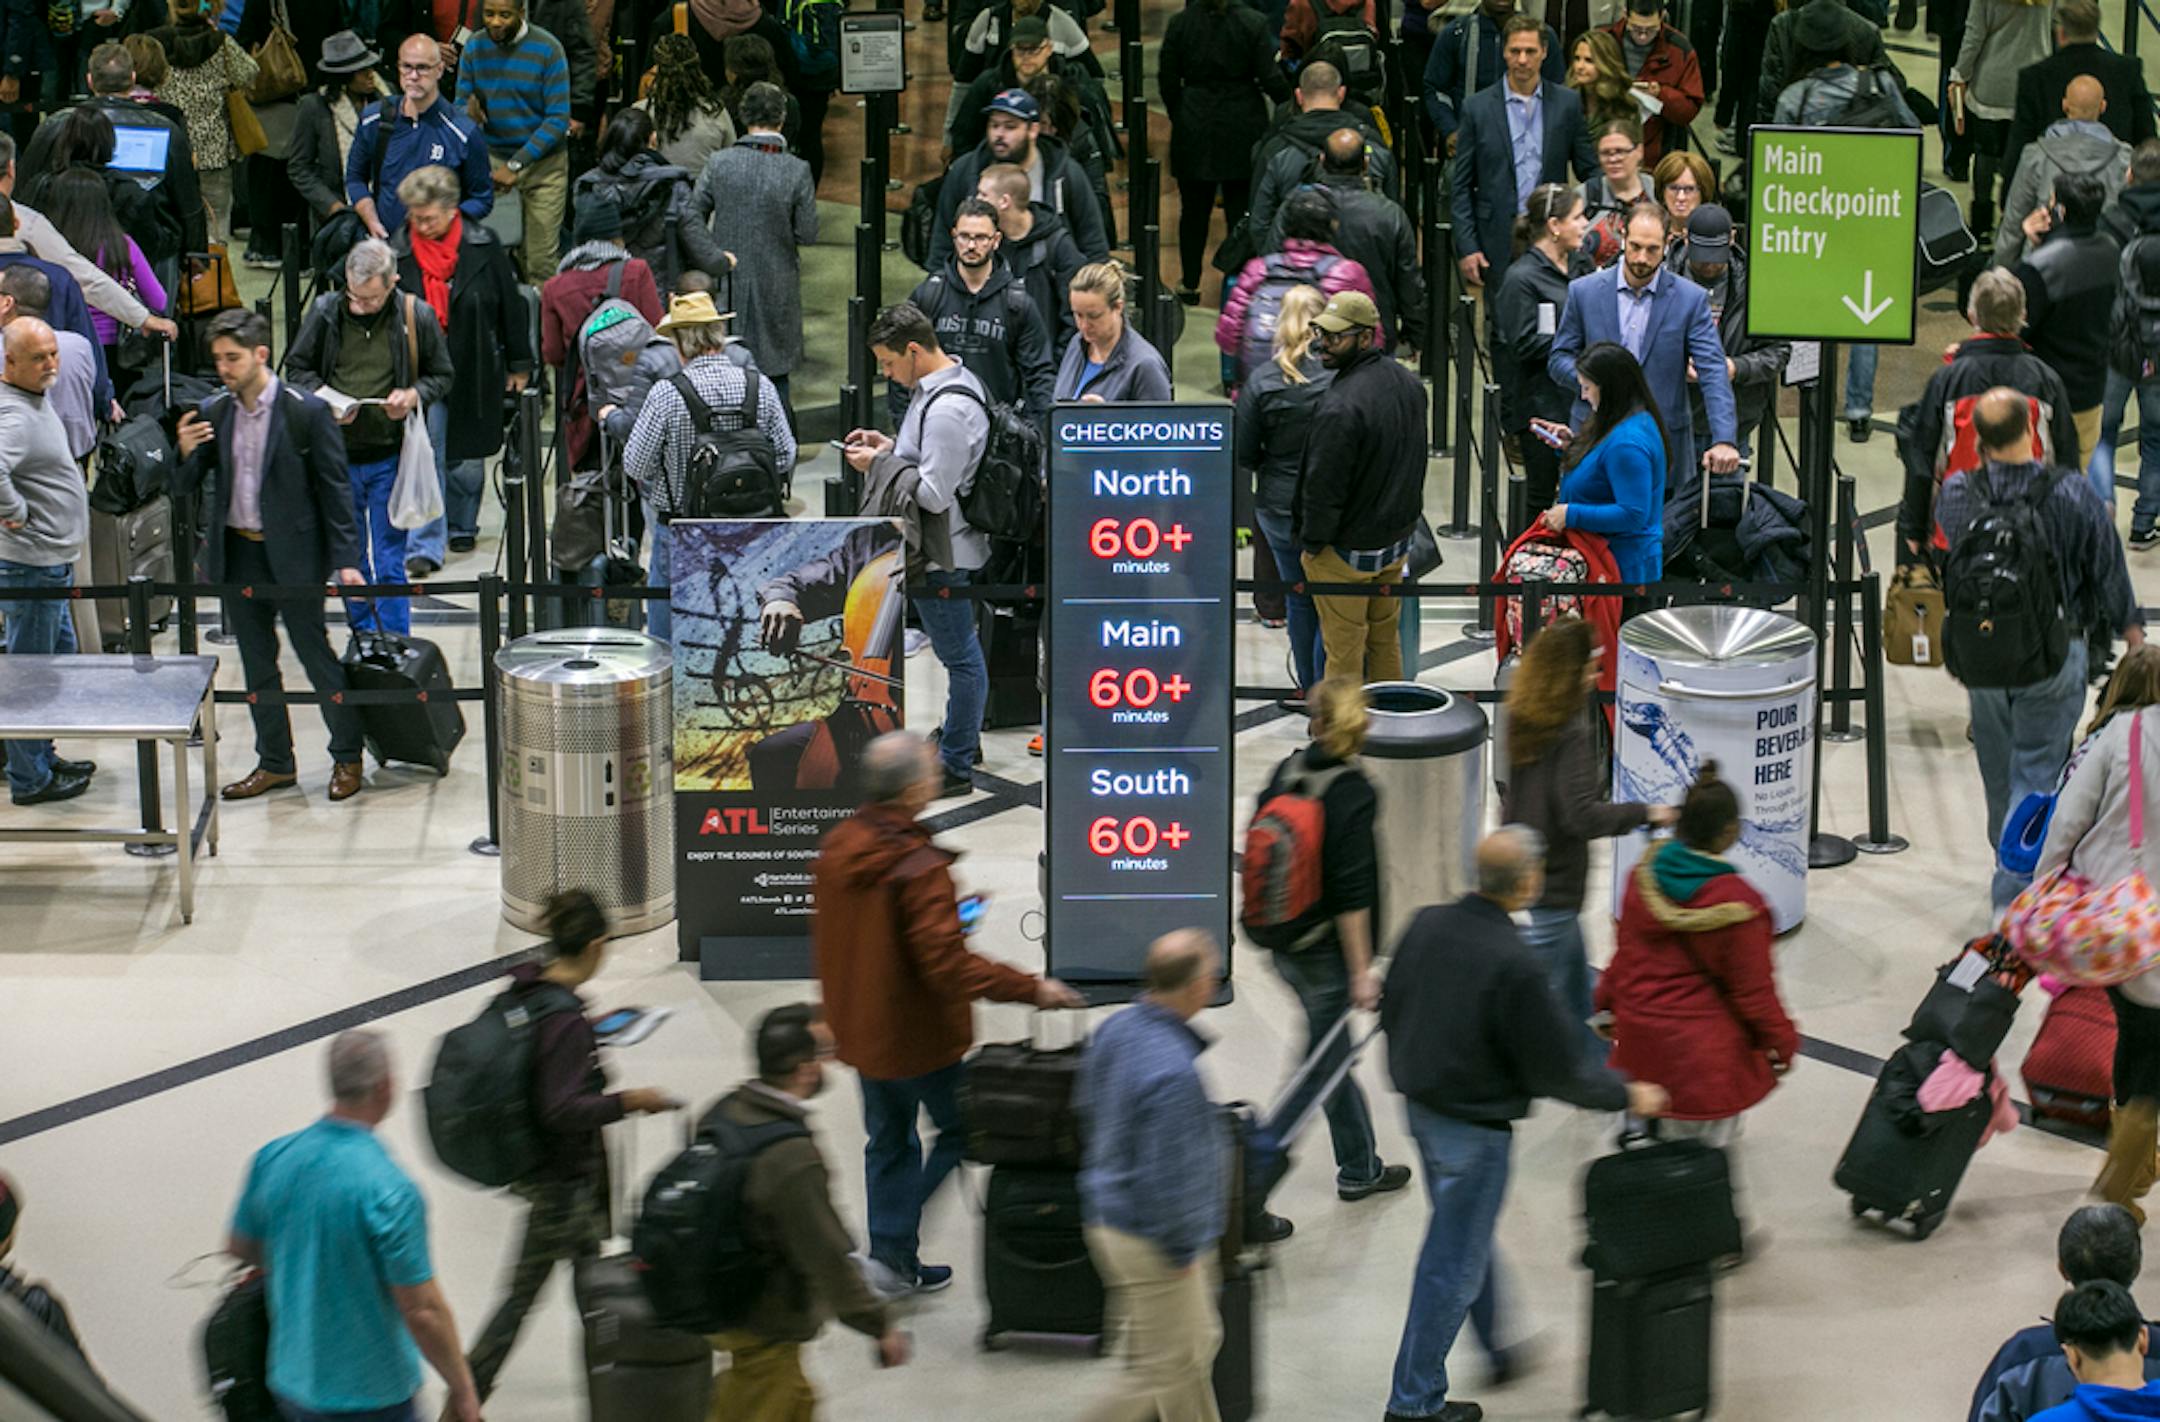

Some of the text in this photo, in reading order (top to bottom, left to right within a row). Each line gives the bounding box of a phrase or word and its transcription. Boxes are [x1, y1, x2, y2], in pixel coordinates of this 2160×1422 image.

[1764, 144, 1822, 175] Main
[1762, 184, 1902, 221] Checkpoint
[1761, 223, 1827, 259] Entry
[1060, 422, 1224, 442] CHECKPOINTS
[1093, 468, 1192, 496] North
[1088, 516, 1194, 559] 60+
[1112, 560, 1171, 574] minutes
[1102, 620, 1181, 648] Main
[1088, 667, 1192, 709] 60+
[1112, 710, 1170, 723] minutes
[1757, 703, 1798, 730] POUR
[1091, 767, 1190, 795] South
[1754, 758, 1793, 785] HERE
[698, 808, 769, 835] ATL
[772, 807, 856, 820] Entertainm
[772, 823, 819, 835] Series
[1088, 815, 1192, 857] 60+
[686, 851, 716, 862] ENJOY
[717, 851, 735, 861] THE
[735, 850, 772, 860] SOUNDS
[773, 850, 786, 860] OF
[1111, 857, 1169, 871] minutes
